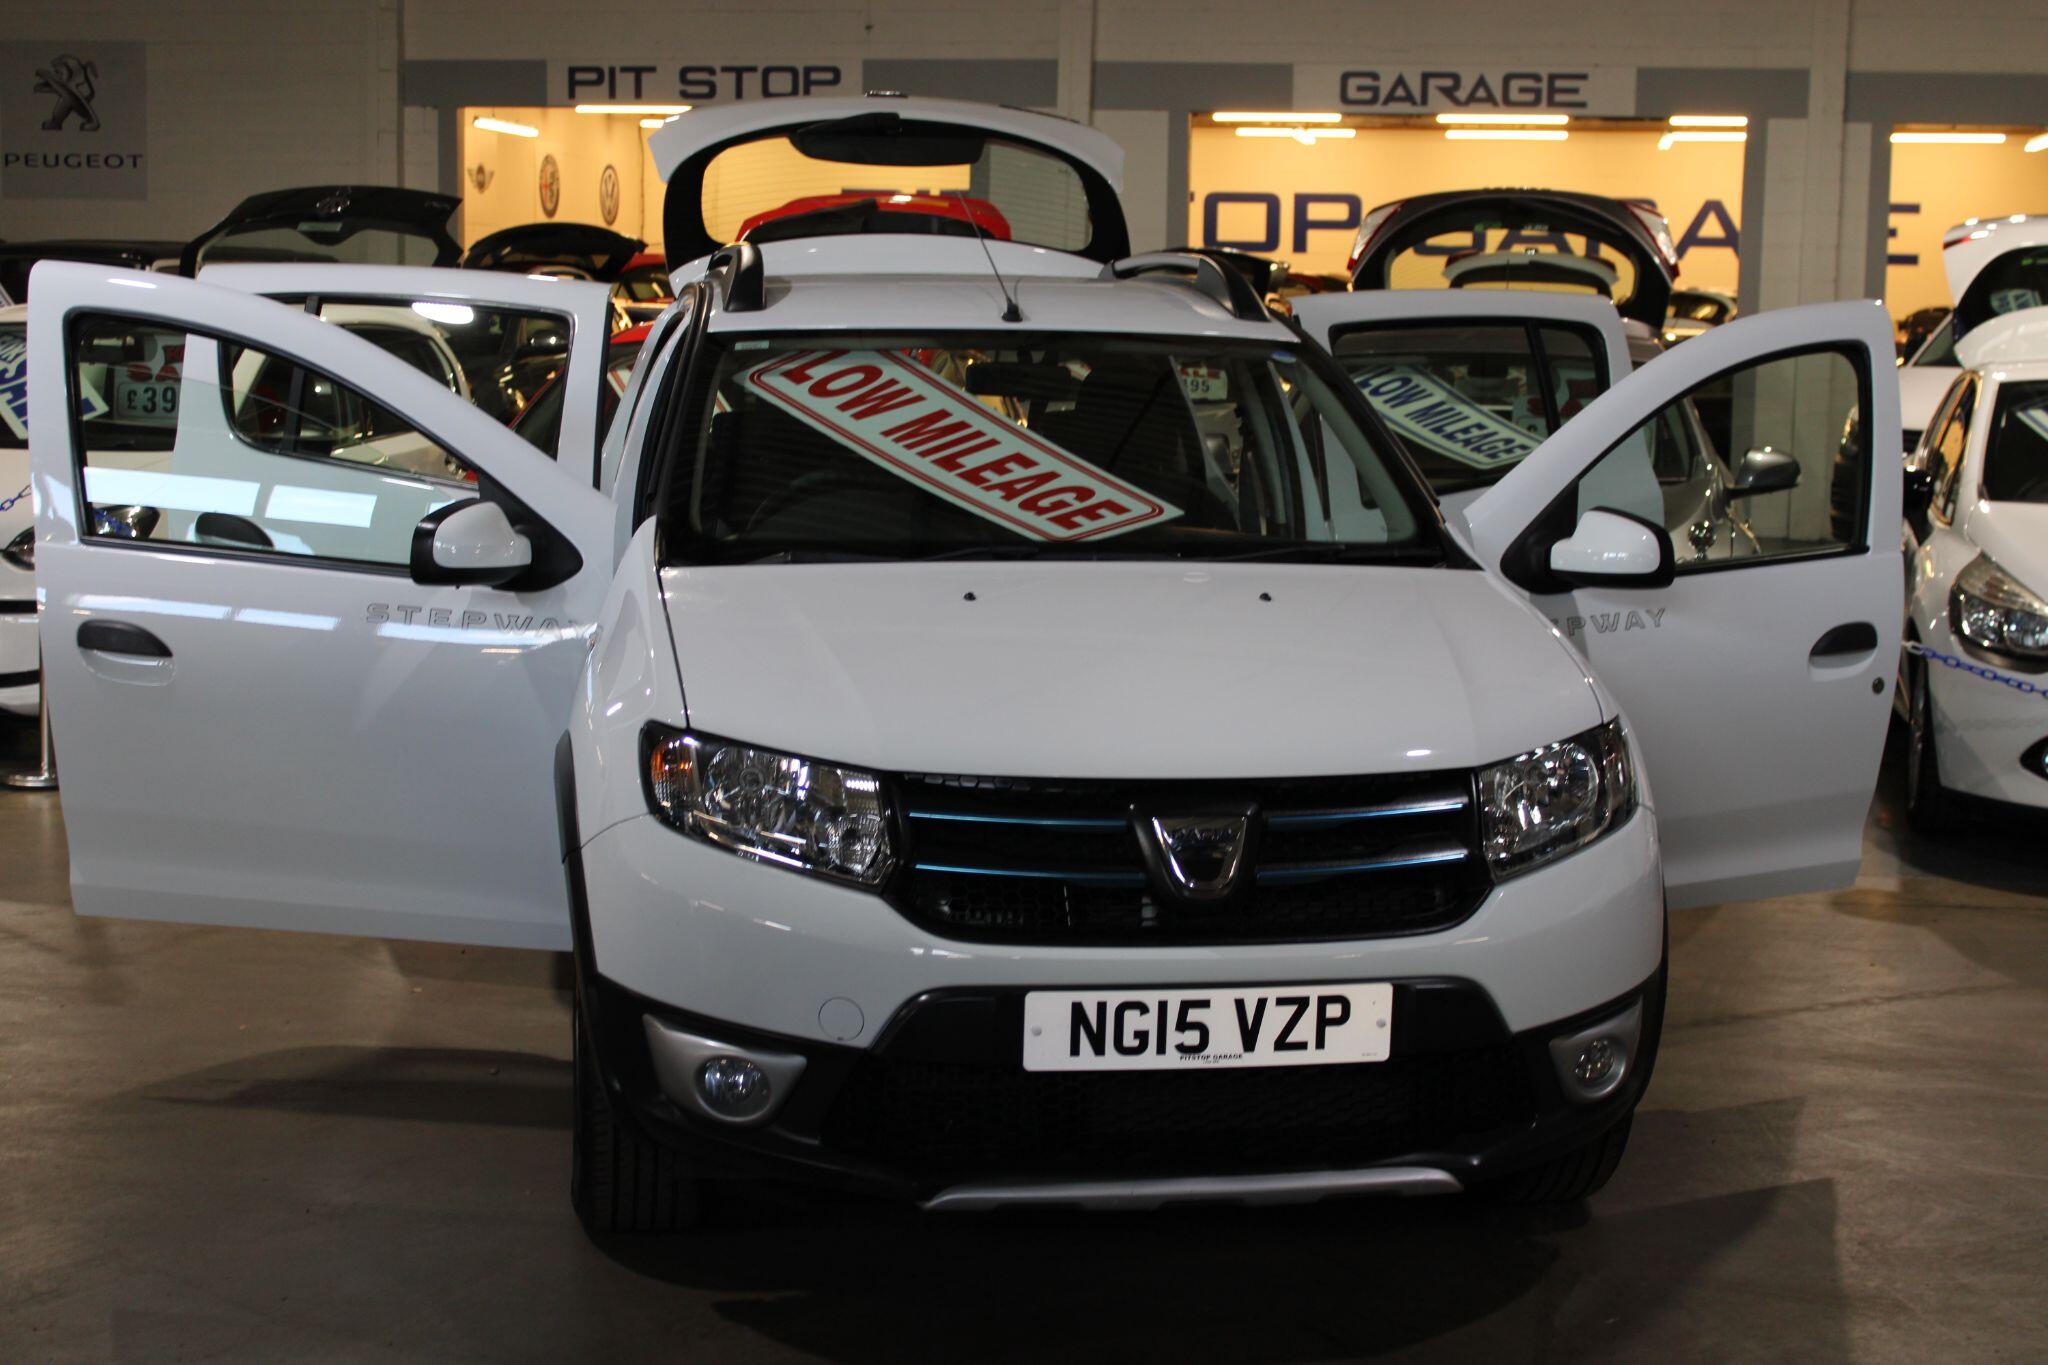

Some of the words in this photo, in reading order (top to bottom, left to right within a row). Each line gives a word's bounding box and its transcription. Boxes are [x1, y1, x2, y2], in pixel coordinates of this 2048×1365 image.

[568, 66, 657, 99] PIT
[679, 65, 842, 100] STOP
[1339, 71, 1589, 108] GARAGE
[4, 153, 143, 169] PEUGEOT
[1354, 366, 1434, 409] LOW
[1404, 401, 1532, 460] MILEAGE
[780, 350, 926, 421] LOW
[880, 409, 1132, 531] MILEAGE
[1069, 999, 1211, 1057] NG15
[1235, 995, 1352, 1053] VZP
